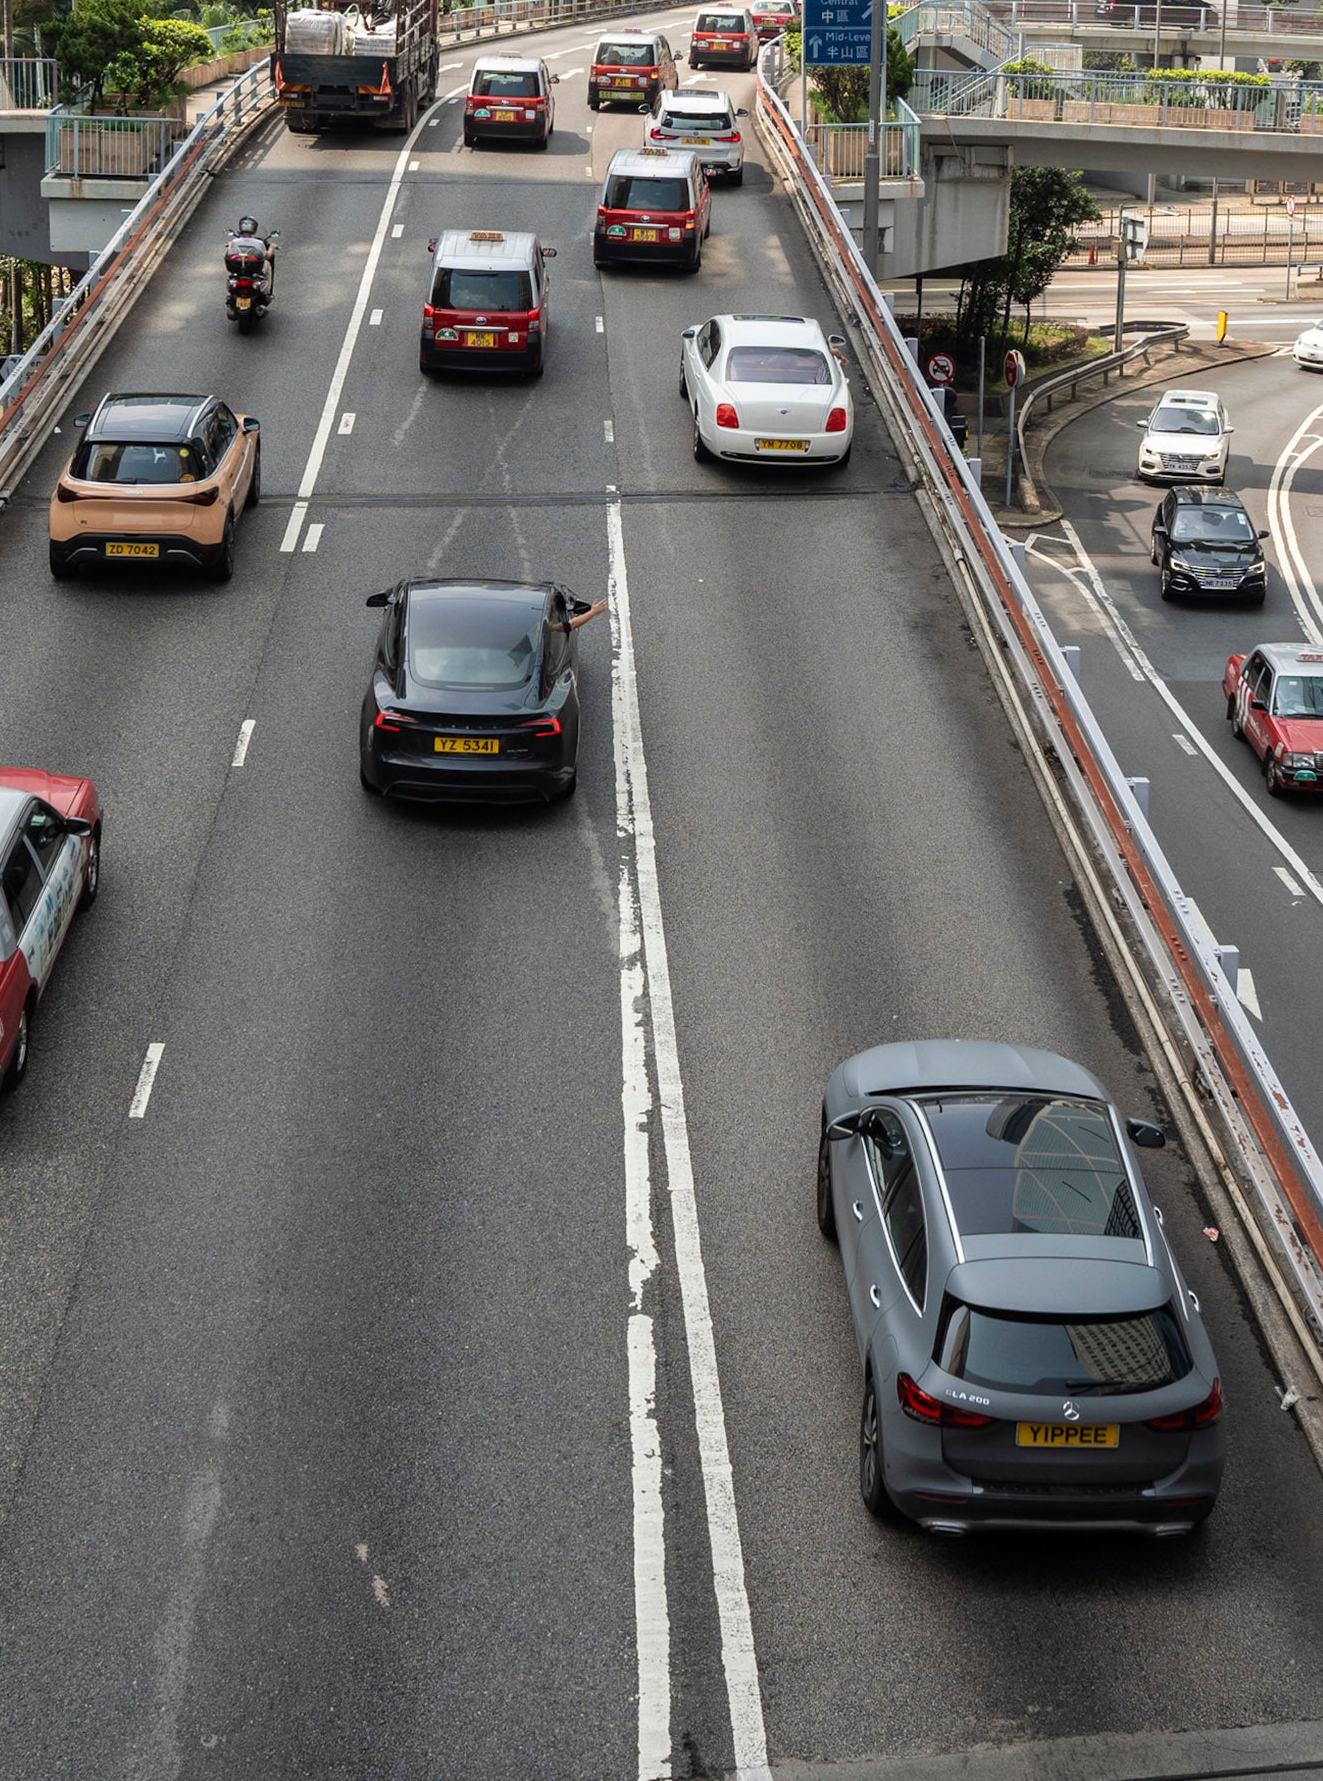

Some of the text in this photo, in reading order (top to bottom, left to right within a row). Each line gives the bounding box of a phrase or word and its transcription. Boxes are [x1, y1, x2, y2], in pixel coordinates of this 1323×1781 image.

[821, 9, 848, 23] 中區
[825, 33, 872, 41] Mid-Leve
[826, 45, 869, 57] 半山區
[761, 440, 776, 449] YM
[109, 544, 156, 555] ZD 7042
[440, 739, 494, 751] YZ 5341
[969, 1396, 990, 1405] 200
[1030, 1426, 1108, 1444] YIPPEE
